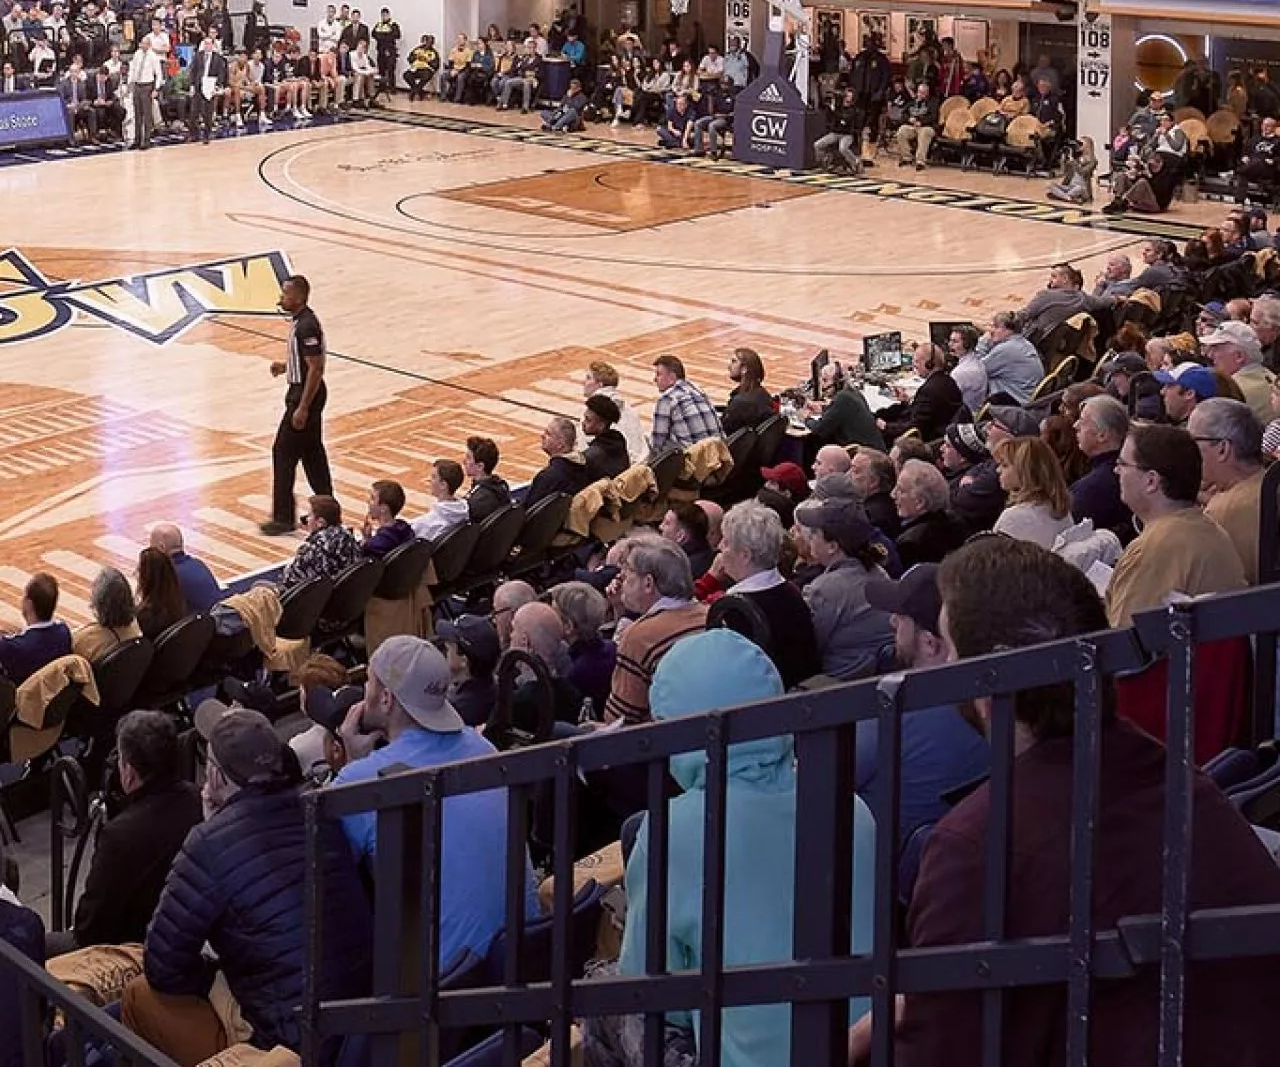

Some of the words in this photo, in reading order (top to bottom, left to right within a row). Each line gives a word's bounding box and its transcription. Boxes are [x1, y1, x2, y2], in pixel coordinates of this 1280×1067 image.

[727, 1, 750, 17] 106
[1081, 31, 1110, 47] 108
[1080, 71, 1109, 87] 107
[10, 114, 39, 131] Store
[751, 114, 788, 139] GW
